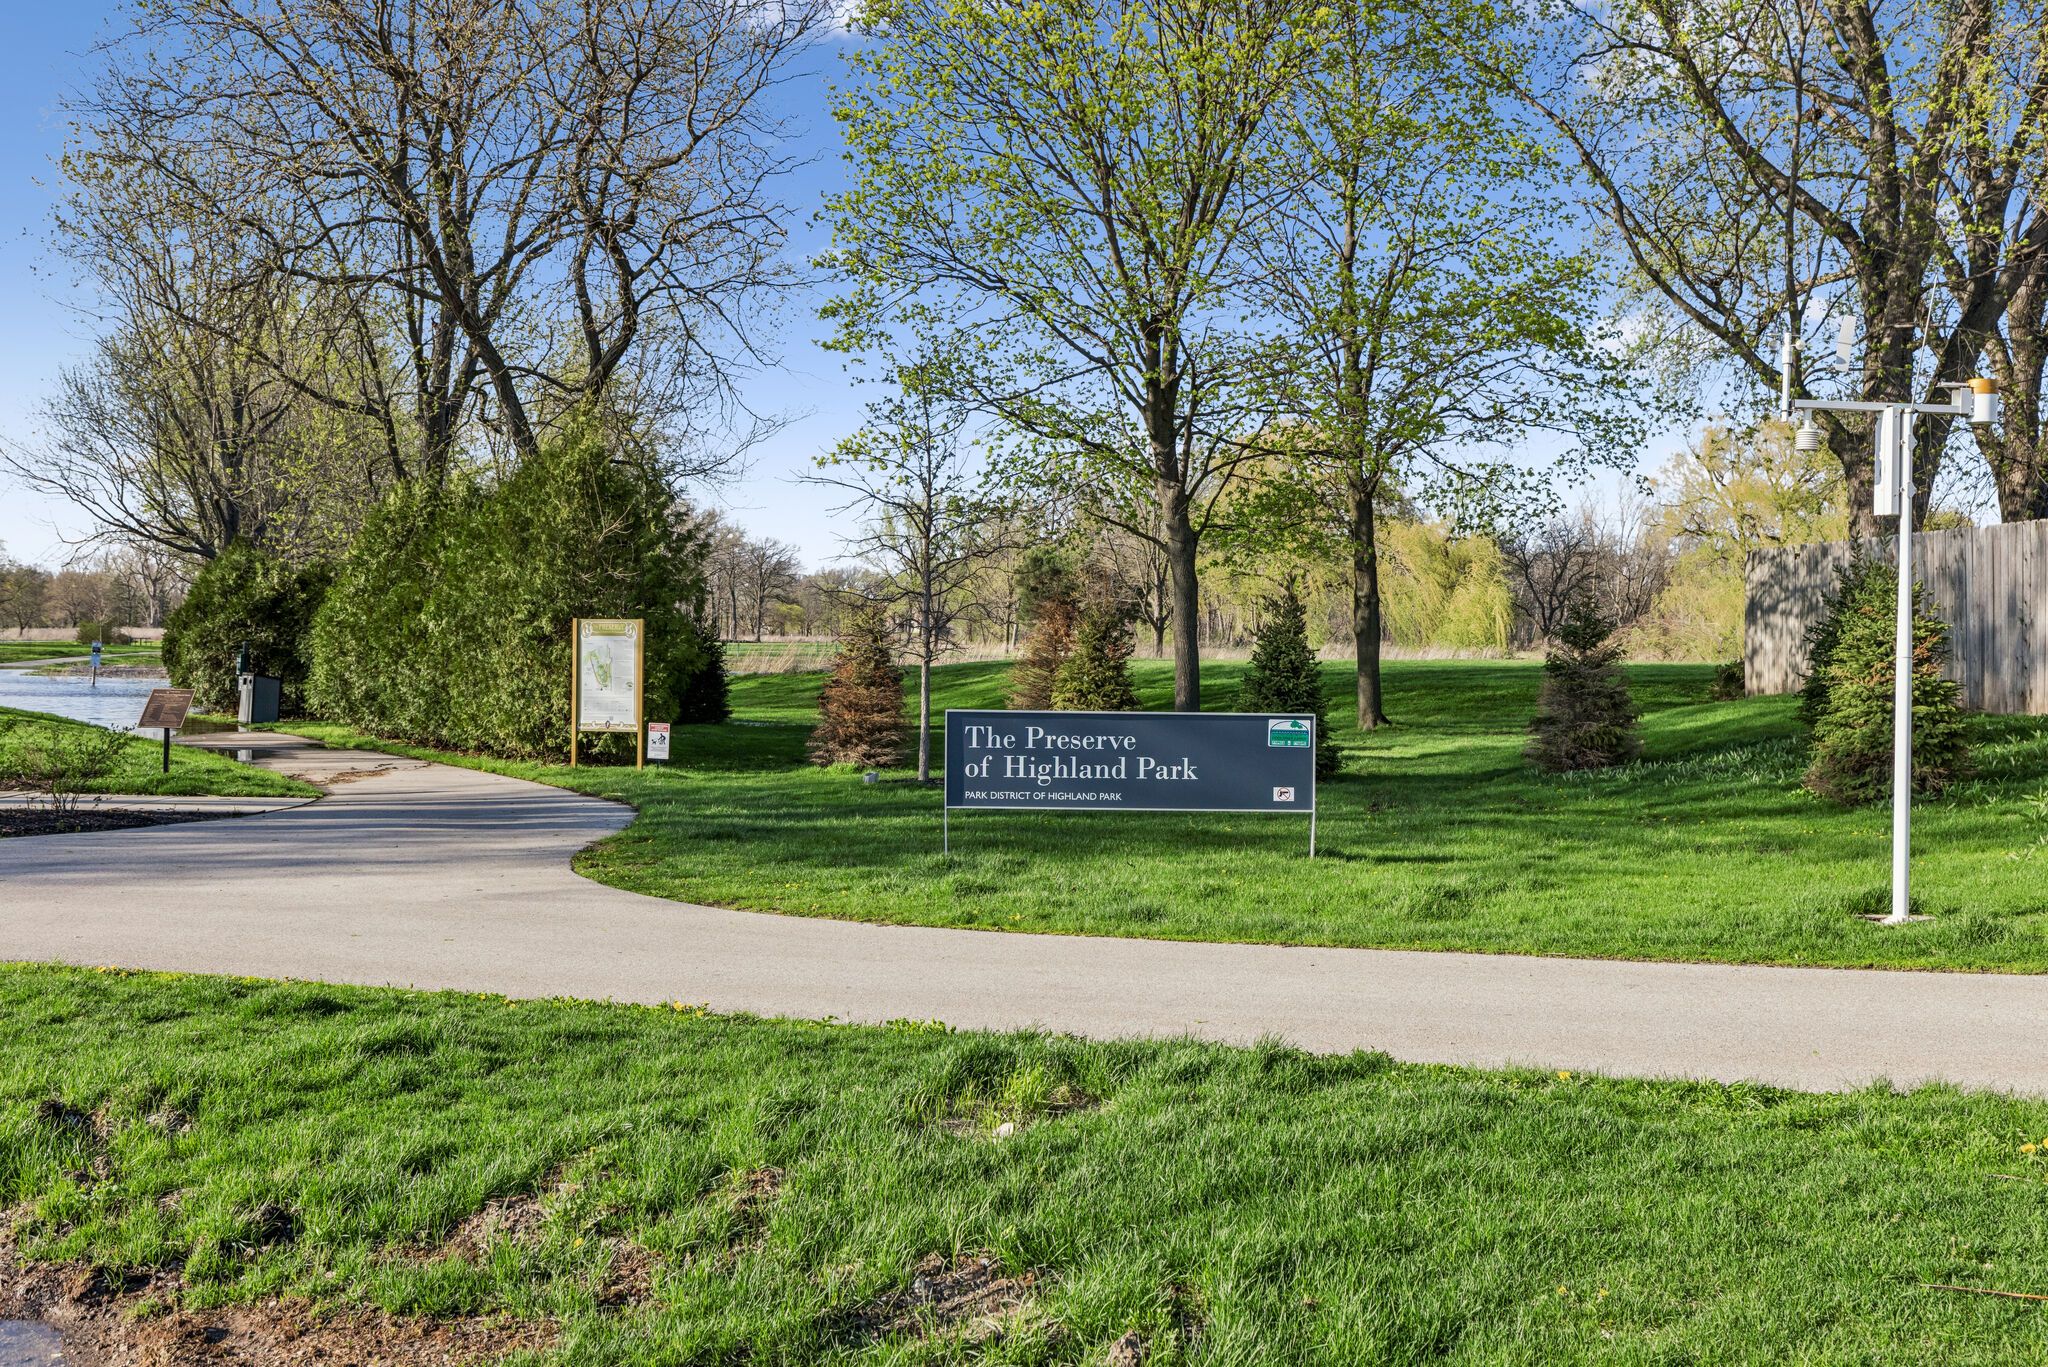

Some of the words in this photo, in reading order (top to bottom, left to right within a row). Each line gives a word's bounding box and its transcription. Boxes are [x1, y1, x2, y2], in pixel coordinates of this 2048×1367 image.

[964, 726, 1016, 749] The
[1025, 727, 1136, 750] Preserve
[965, 755, 993, 778] of
[1003, 756, 1127, 786] Highland
[1136, 757, 1199, 780] Park
[965, 791, 988, 800] PARK
[990, 791, 1030, 801] DISTRICT
[1033, 791, 1046, 801] OF
[1048, 792, 1097, 801] HIGHLAND
[1100, 792, 1122, 801] PARK
